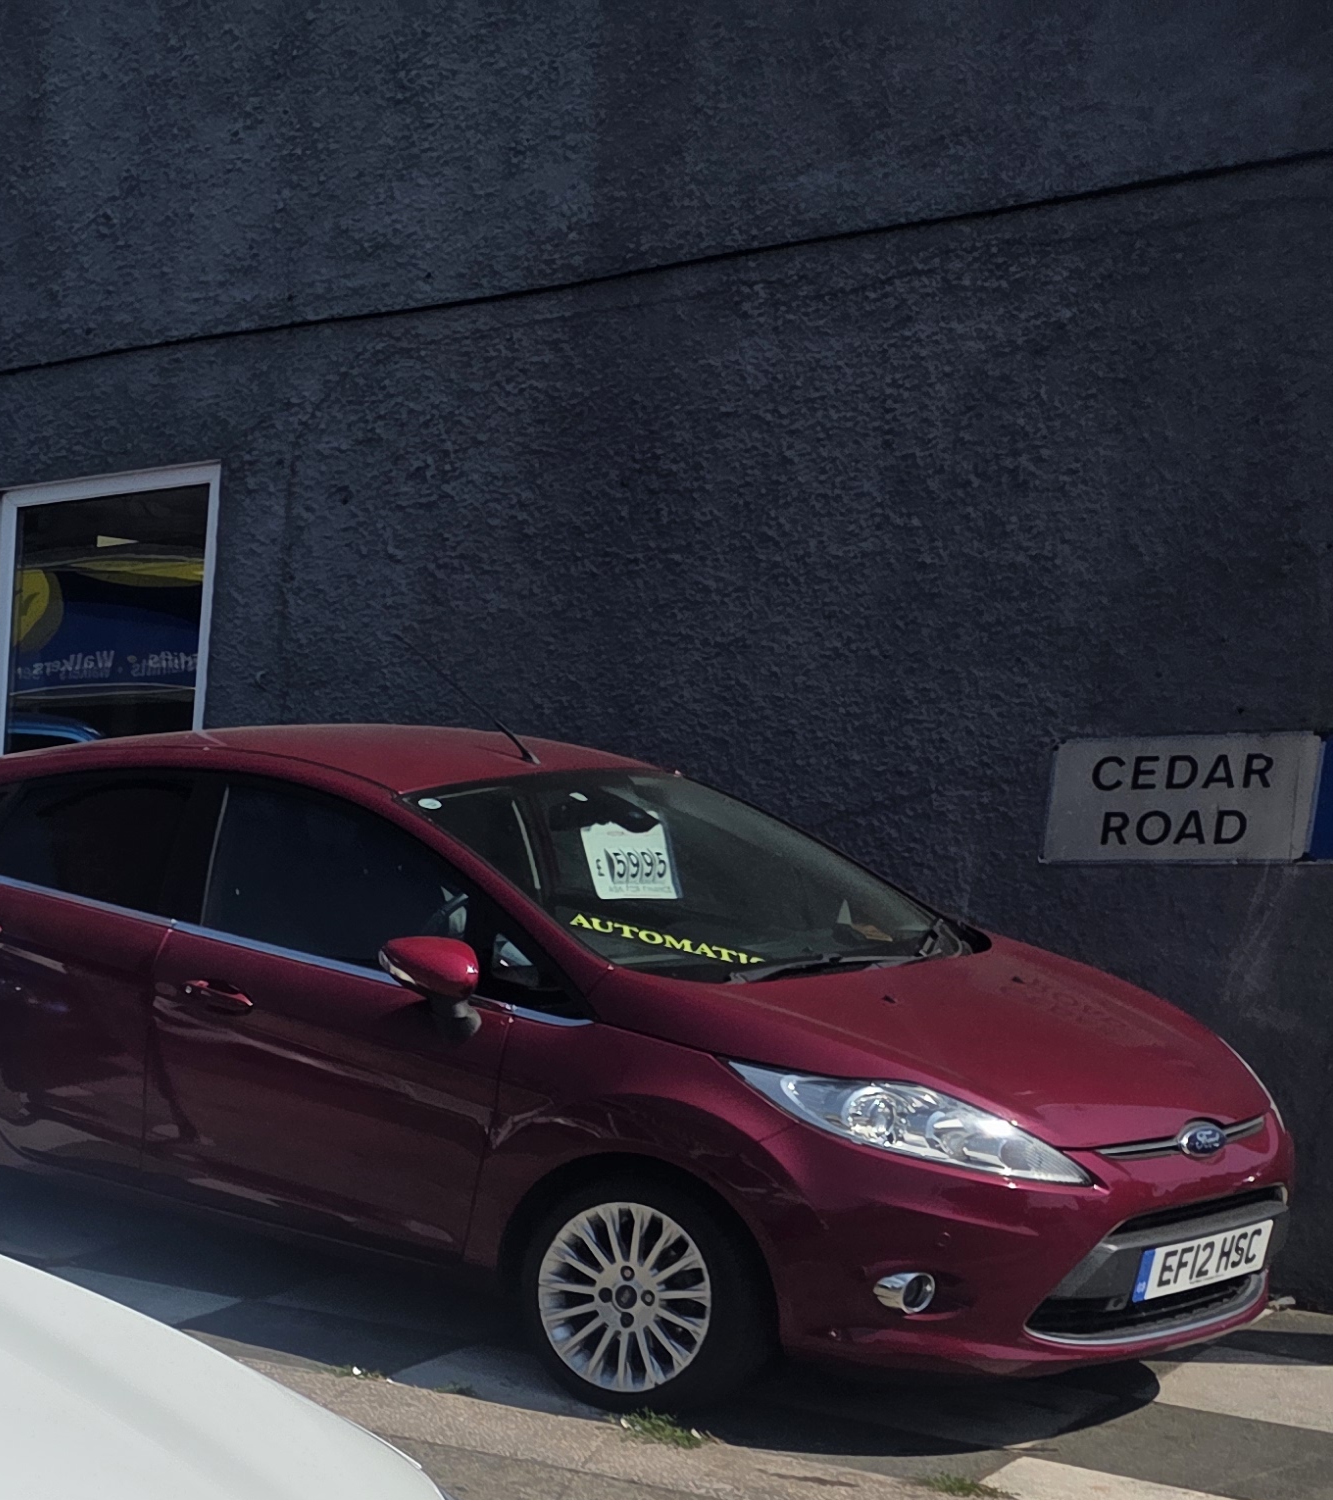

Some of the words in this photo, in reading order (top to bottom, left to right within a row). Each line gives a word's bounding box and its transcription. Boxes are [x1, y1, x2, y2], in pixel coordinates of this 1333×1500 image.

[1091, 753, 1274, 791] CEDAR
[1100, 809, 1247, 846] ROAD
[1156, 1240, 1215, 1289] EF12
[1215, 1227, 1263, 1274] HSC
